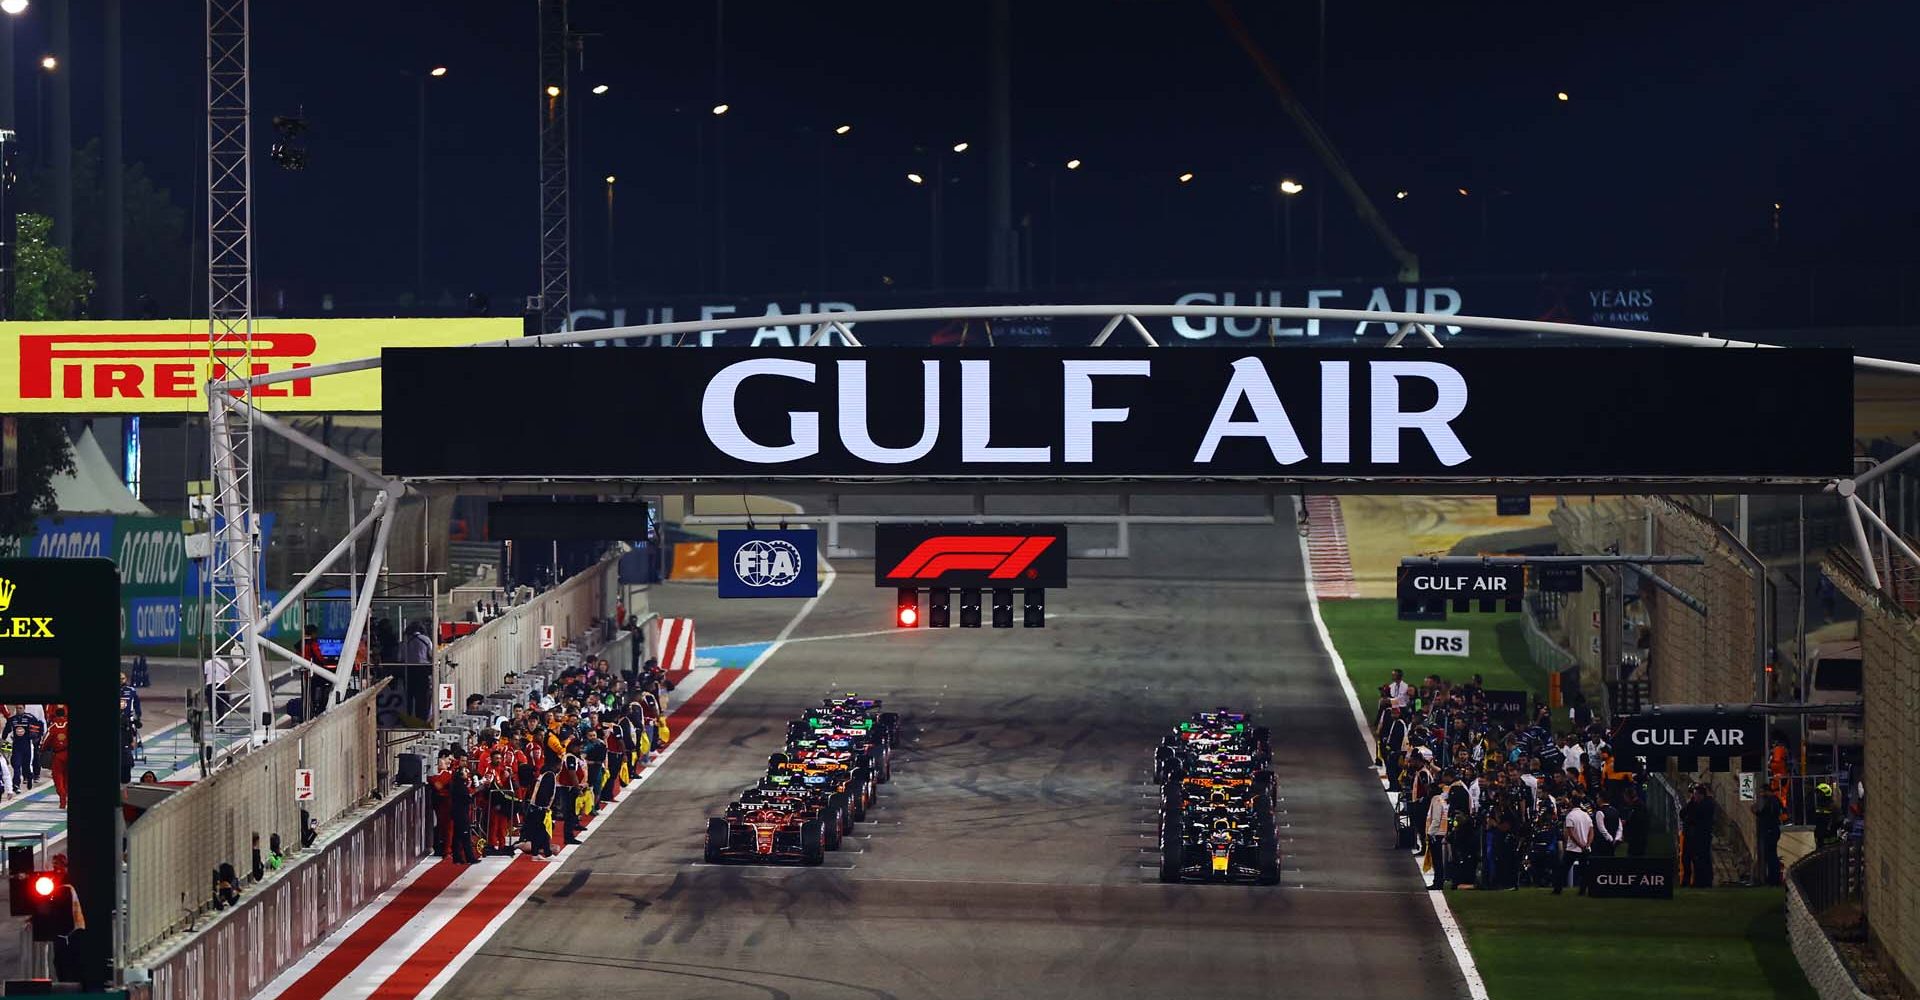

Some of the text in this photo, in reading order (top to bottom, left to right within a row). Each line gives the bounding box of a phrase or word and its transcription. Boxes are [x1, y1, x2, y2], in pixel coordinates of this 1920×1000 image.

[1171, 287, 1463, 340] GULF AIR
[1589, 290, 1654, 308] YEARS
[750, 302, 860, 347] AIR
[20, 333, 317, 399] PIRELLI
[702, 357, 1471, 466] GULF AIR
[120, 530, 181, 584] aramco
[1413, 575, 1508, 591] GULF AIR
[137, 603, 177, 638] aramco
[1421, 636, 1463, 652] DRS
[1631, 728, 1745, 746] GULF AIR
[1596, 874, 1665, 886] GULF AIR
